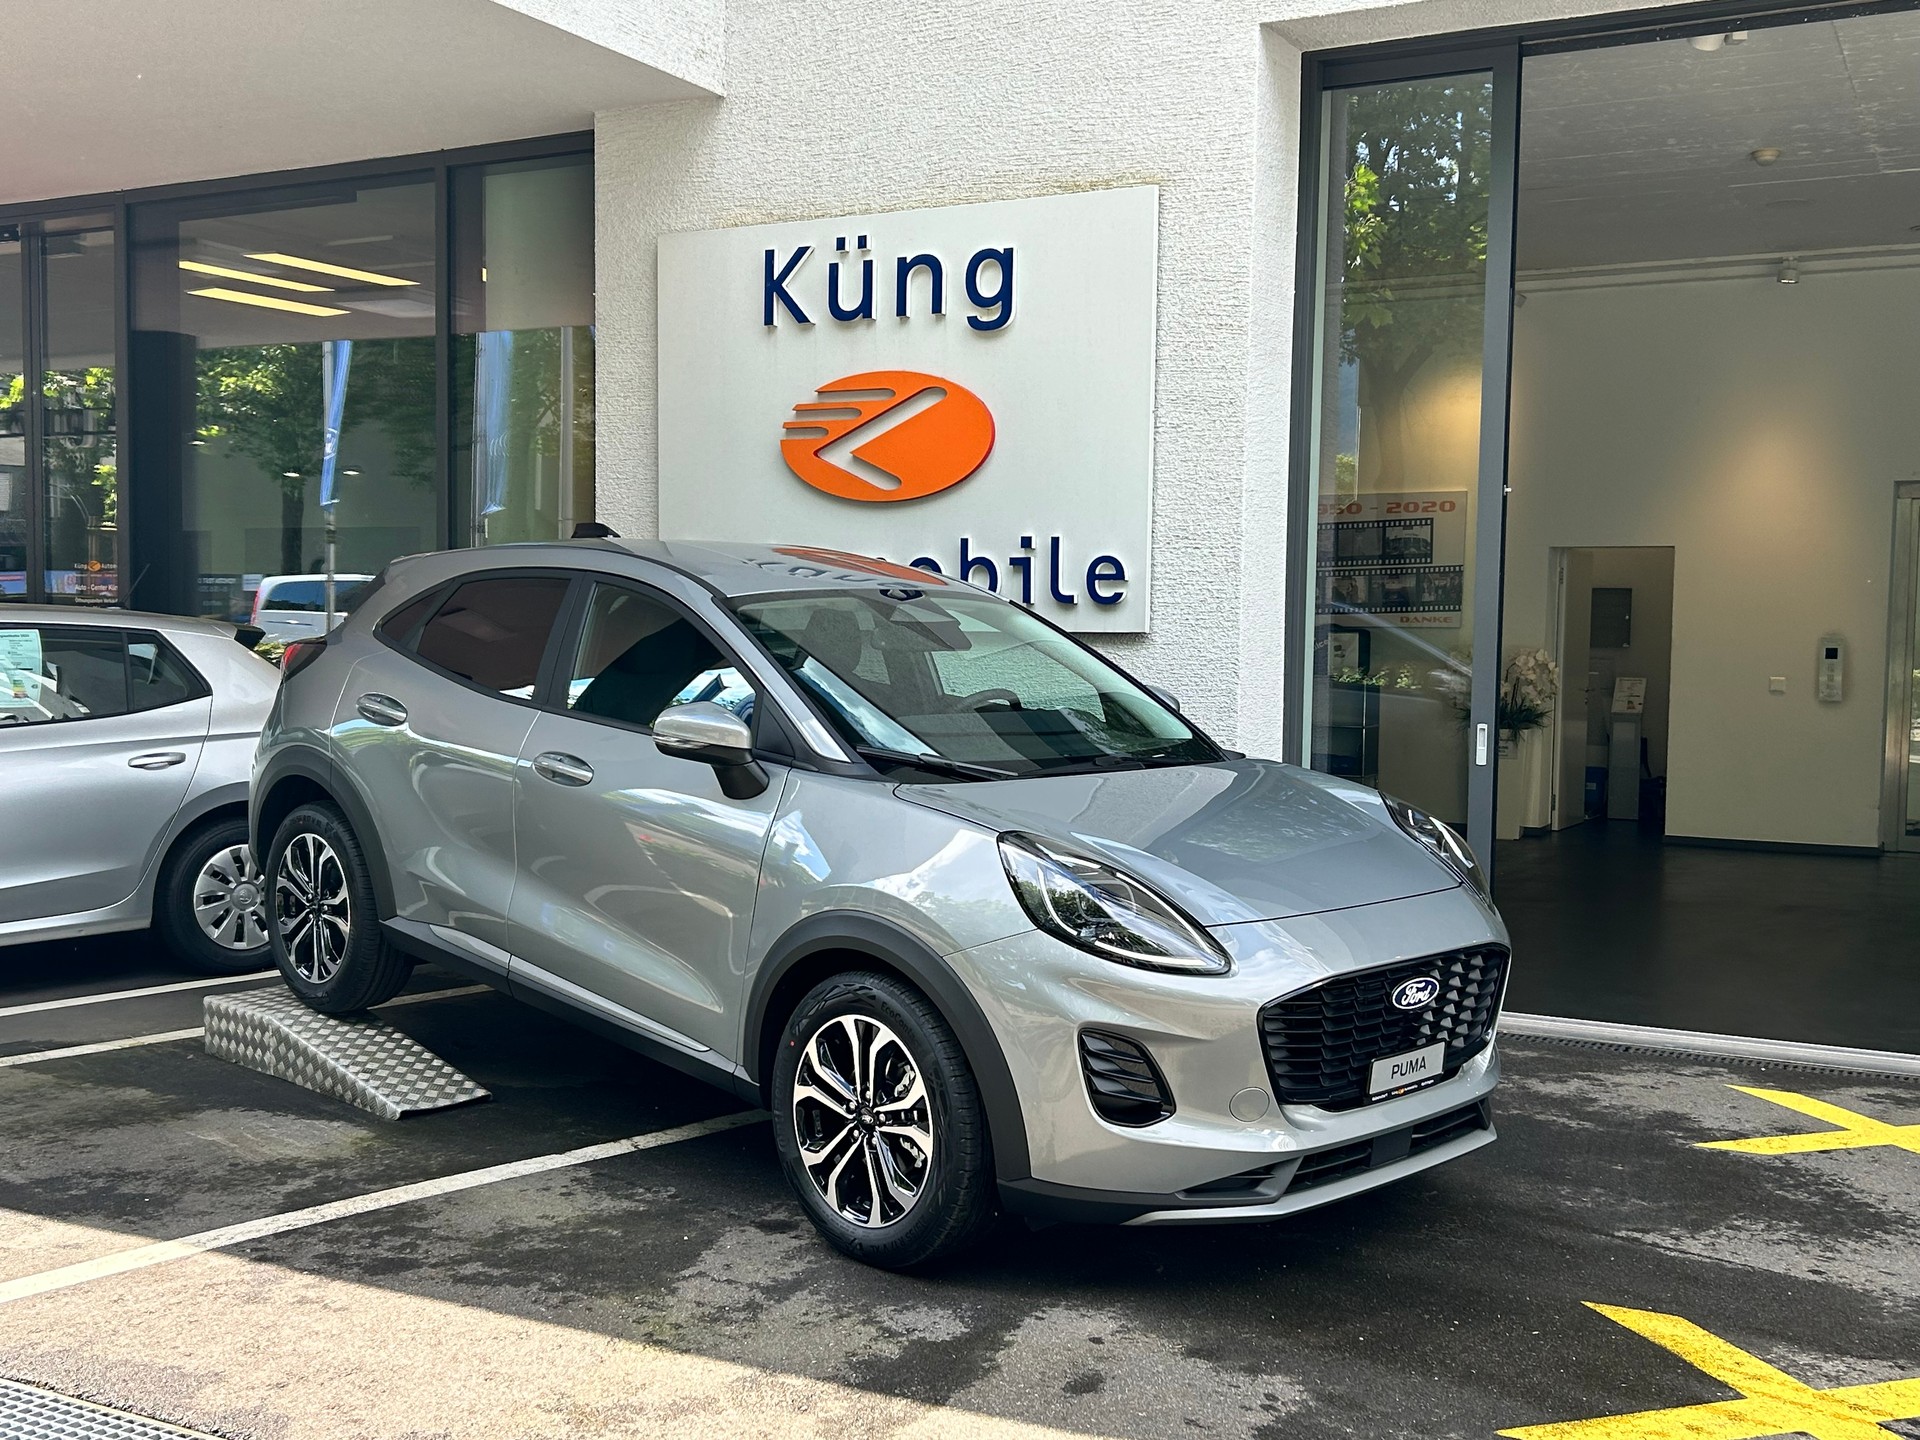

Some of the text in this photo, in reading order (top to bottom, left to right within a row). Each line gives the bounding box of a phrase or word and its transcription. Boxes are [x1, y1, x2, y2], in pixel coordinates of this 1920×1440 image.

[764, 235, 1015, 331] Küng
[1386, 500, 1456, 514] 2020
[1400, 616, 1453, 624] DANKE
[1401, 982, 1432, 1005] Ford
[1391, 1056, 1427, 1080] PUMA
